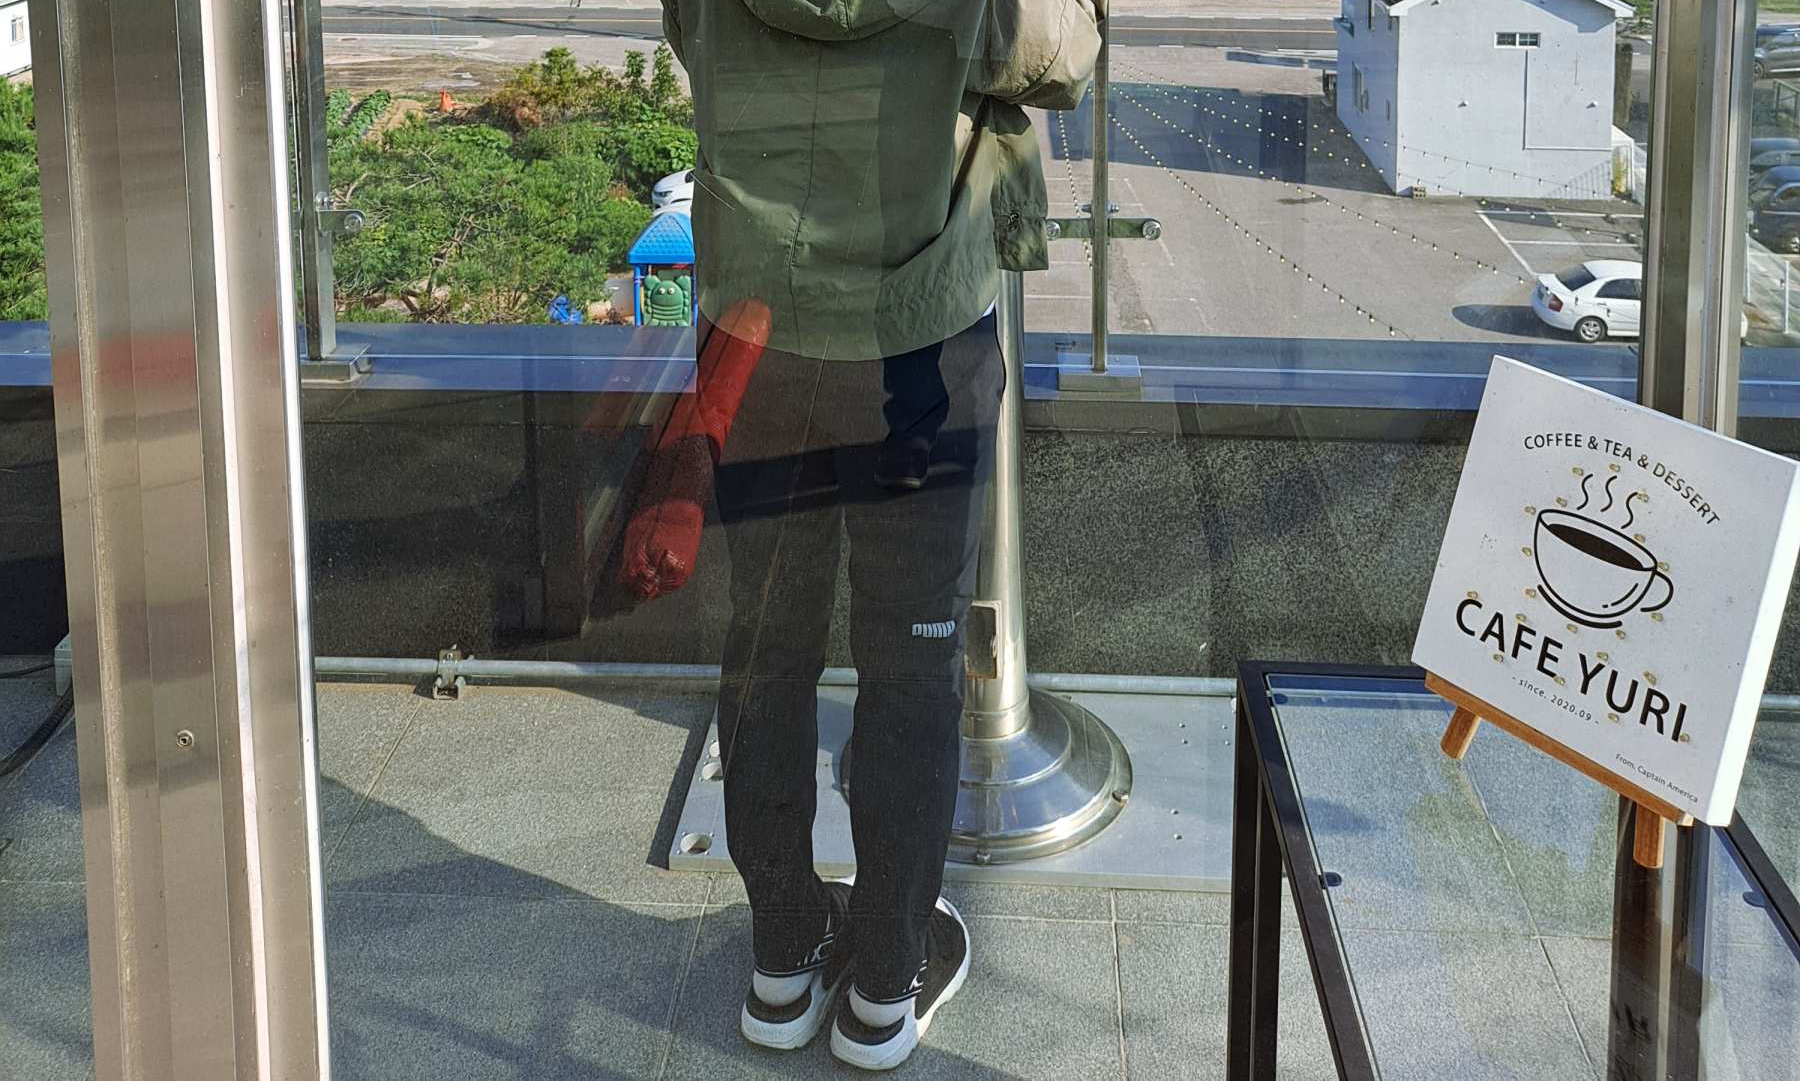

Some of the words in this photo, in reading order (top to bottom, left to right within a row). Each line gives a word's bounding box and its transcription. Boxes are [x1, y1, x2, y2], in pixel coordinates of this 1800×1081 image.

[1524, 433, 1583, 450] COFFEE
[1587, 435, 1599, 450] &
[1603, 438, 1632, 461] TEA
[1637, 454, 1649, 469] &
[1652, 462, 1721, 525] DESSERT
[1455, 598, 1563, 679] CAFE
[1578, 653, 1687, 743] YURI
[1637, 765, 1666, 785] Captain
[1666, 782, 1698, 803] America
